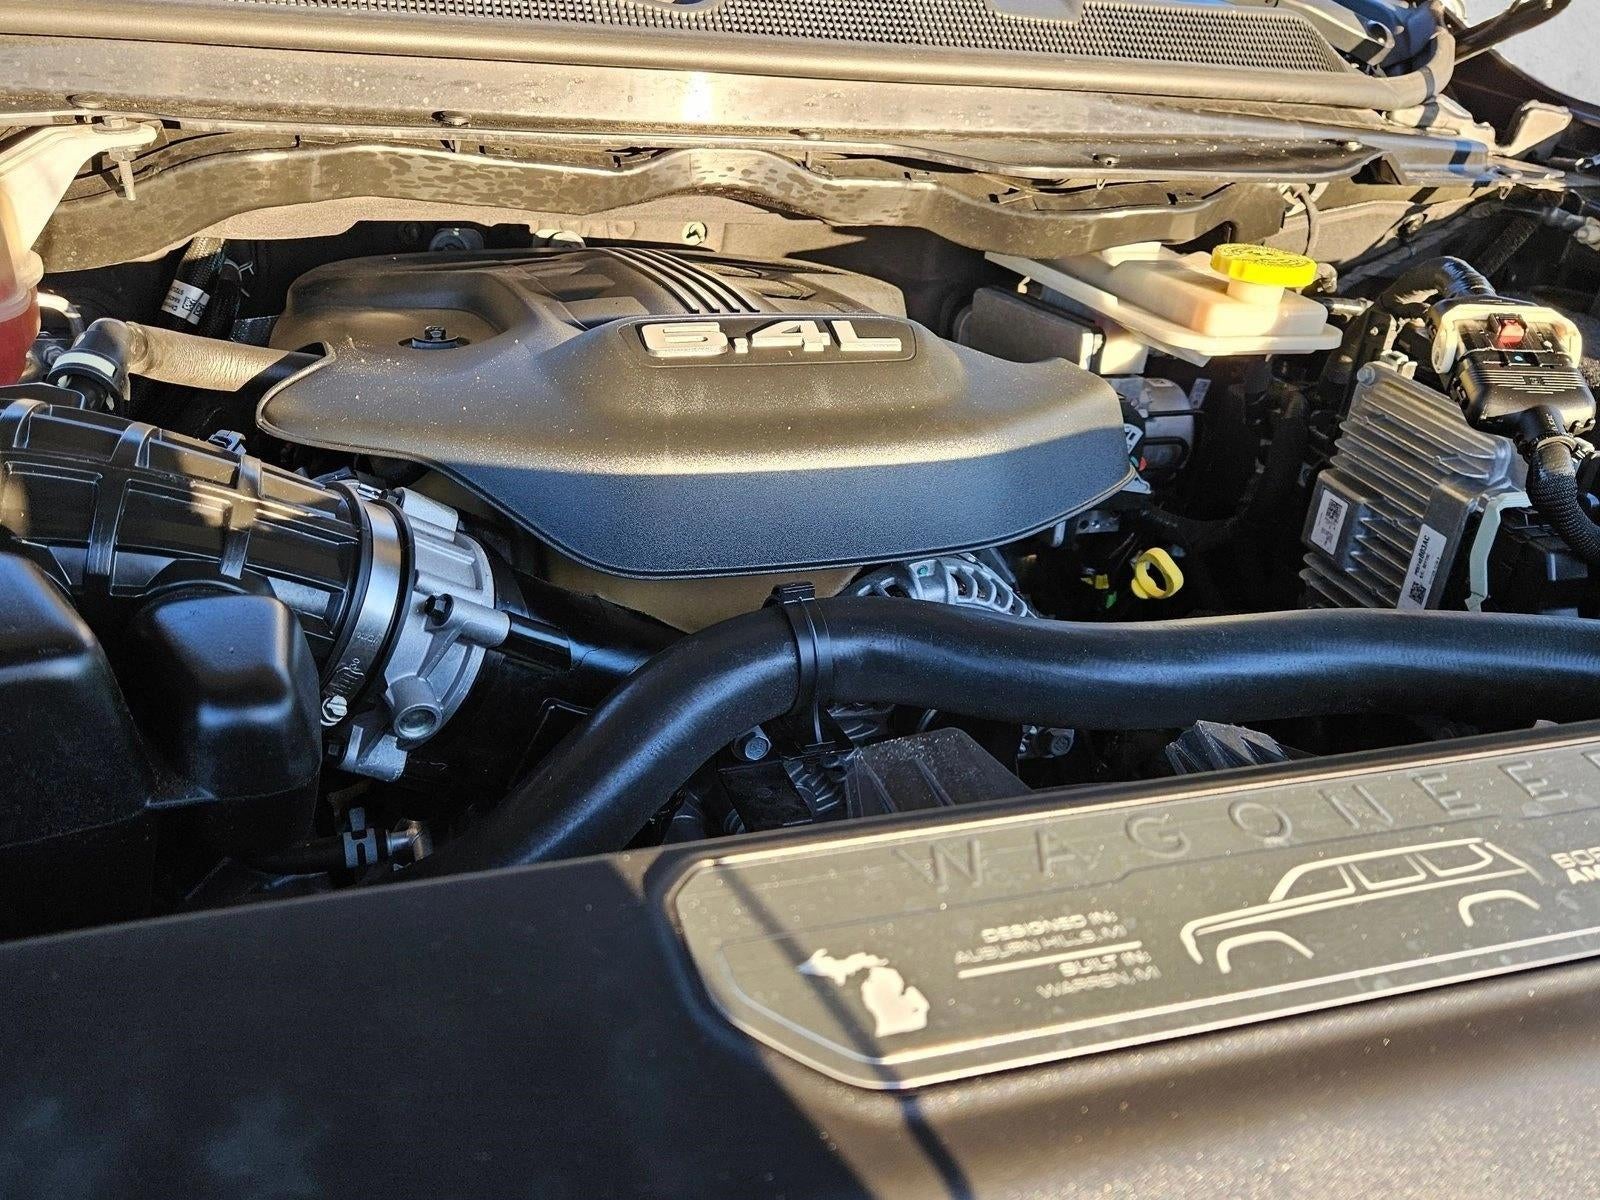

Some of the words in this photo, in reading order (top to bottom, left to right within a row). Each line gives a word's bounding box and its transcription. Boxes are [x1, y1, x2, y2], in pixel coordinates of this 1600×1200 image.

[638, 318, 903, 358] 6.4L
[889, 751, 1600, 894] WAGONEE
[981, 914, 1087, 944] DESIGNED
[1059, 953, 1118, 977] BUILT
